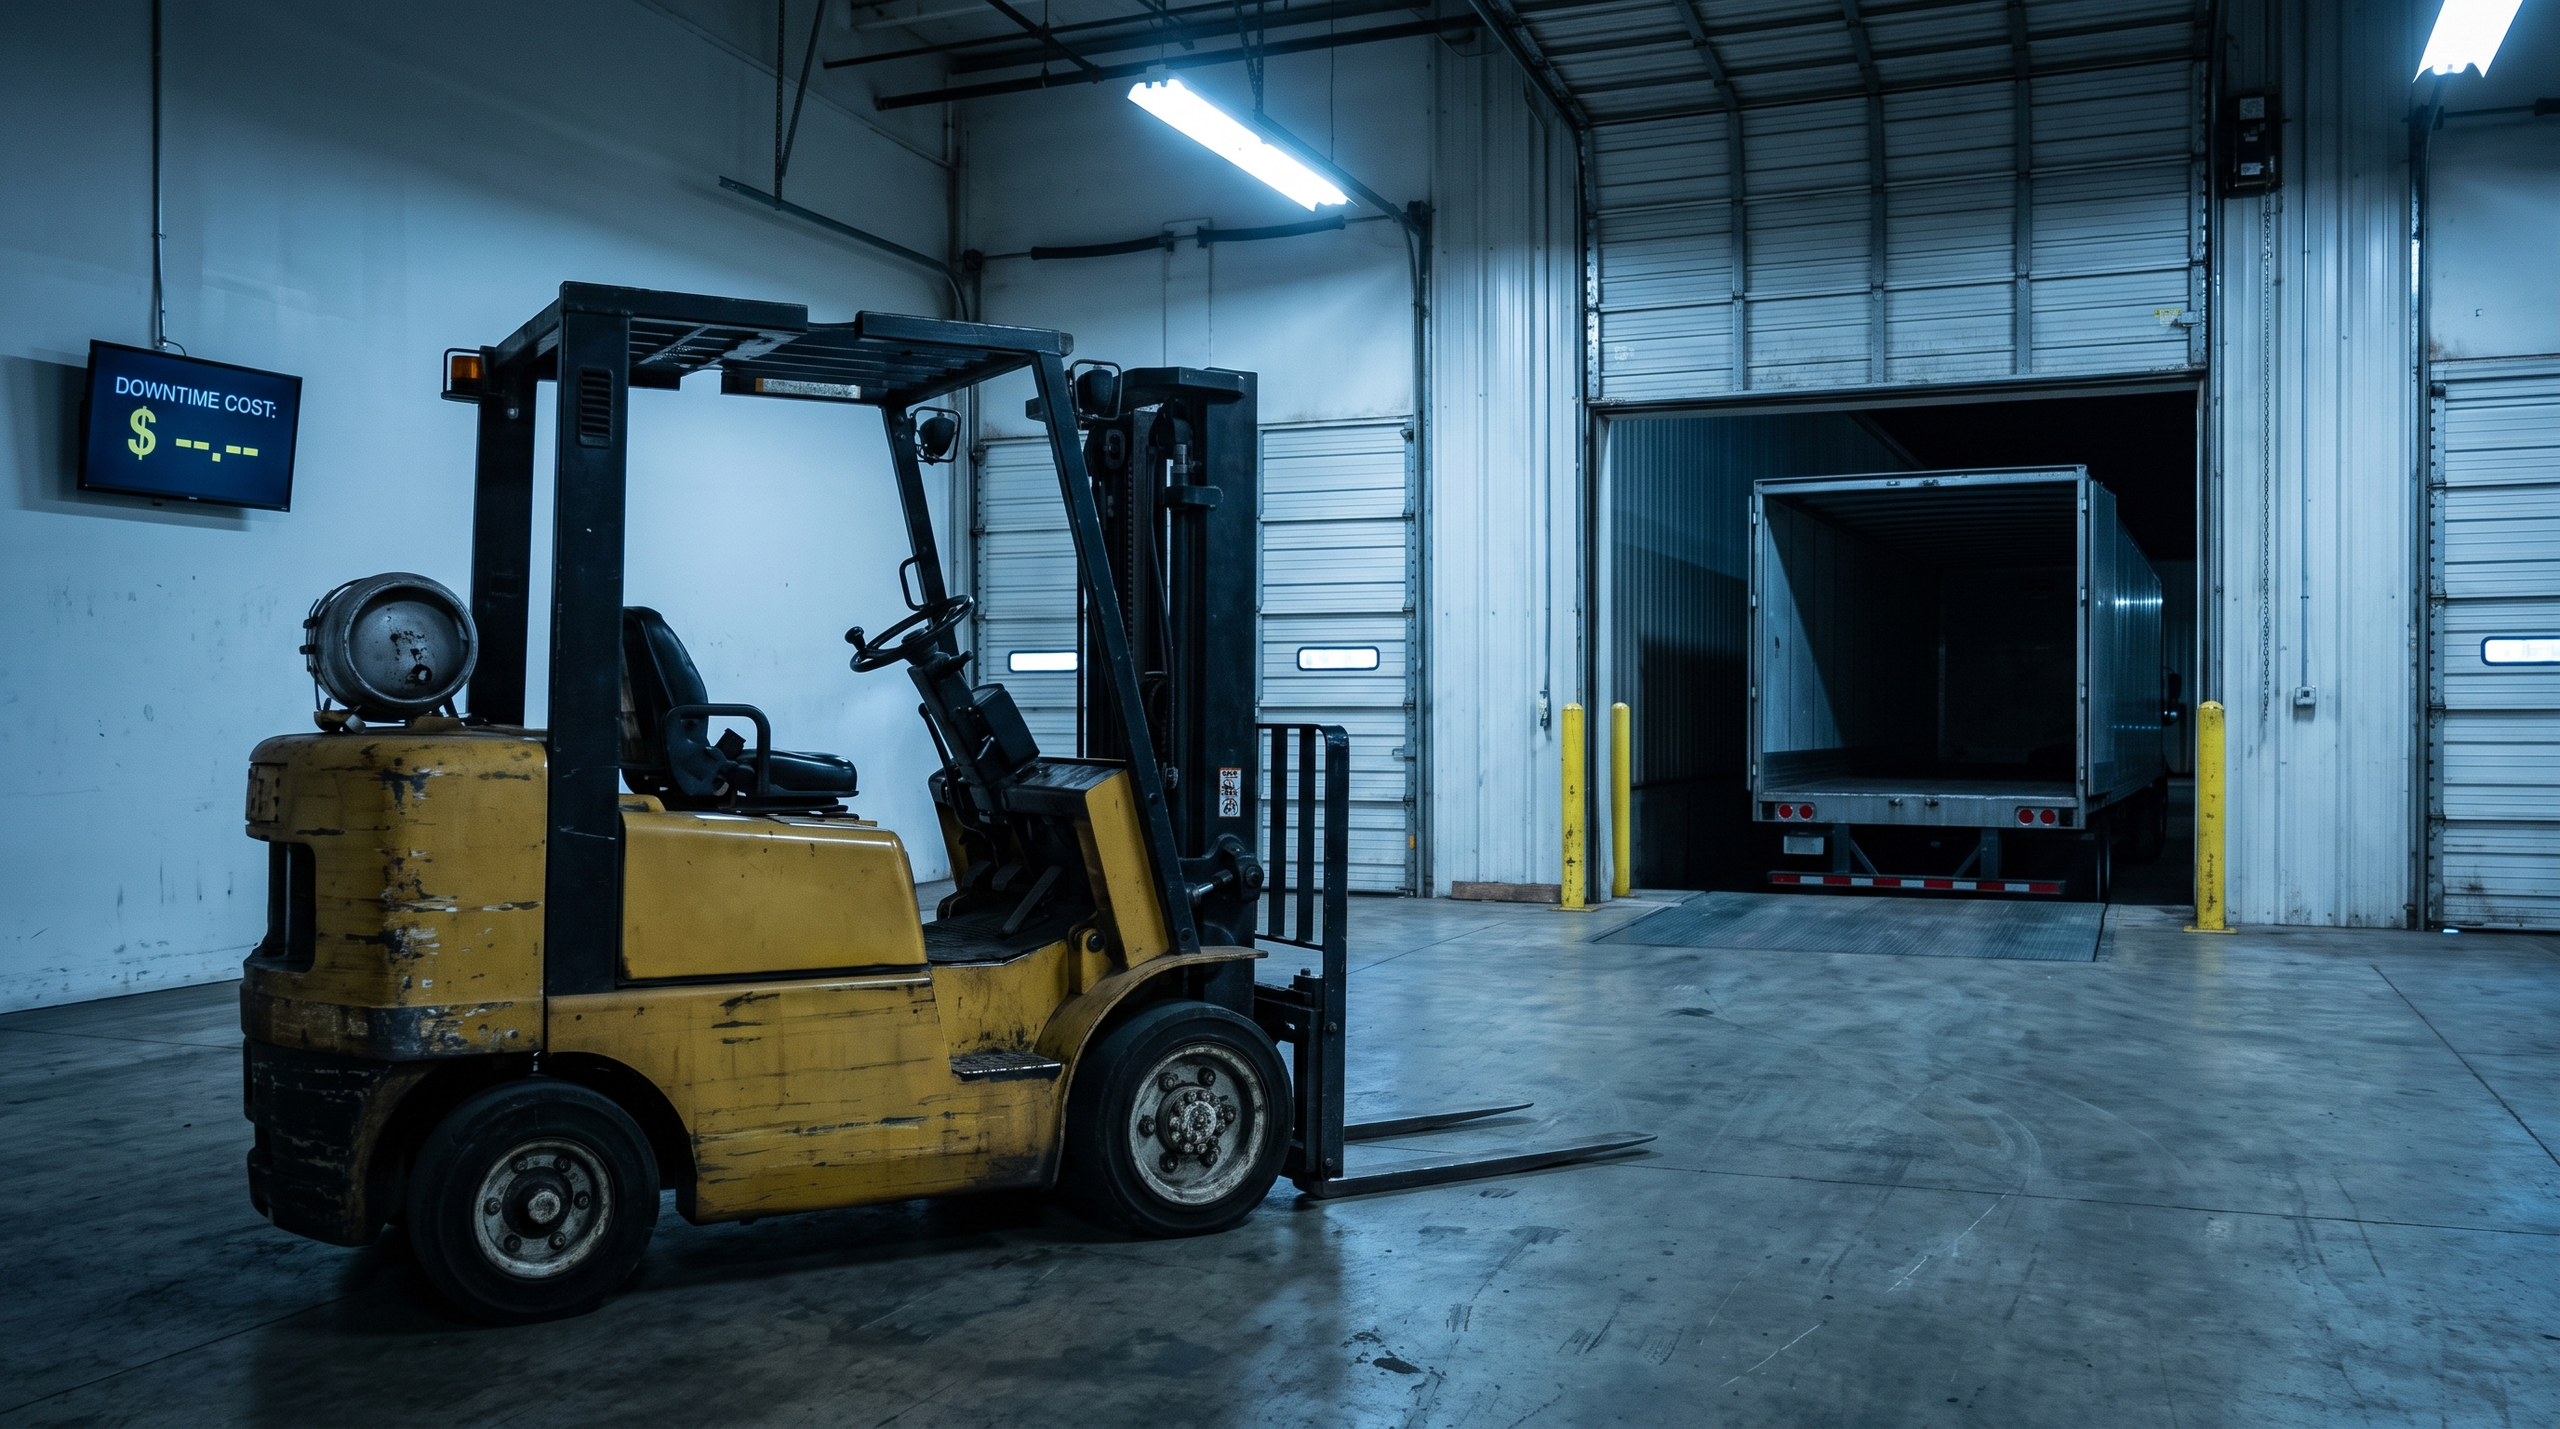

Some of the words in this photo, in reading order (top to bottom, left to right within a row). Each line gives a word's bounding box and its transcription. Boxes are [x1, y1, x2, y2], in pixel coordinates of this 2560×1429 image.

[115, 376, 220, 409] DOWNTIME
[225, 394, 276, 418] COST:
[127, 405, 156, 460] $
